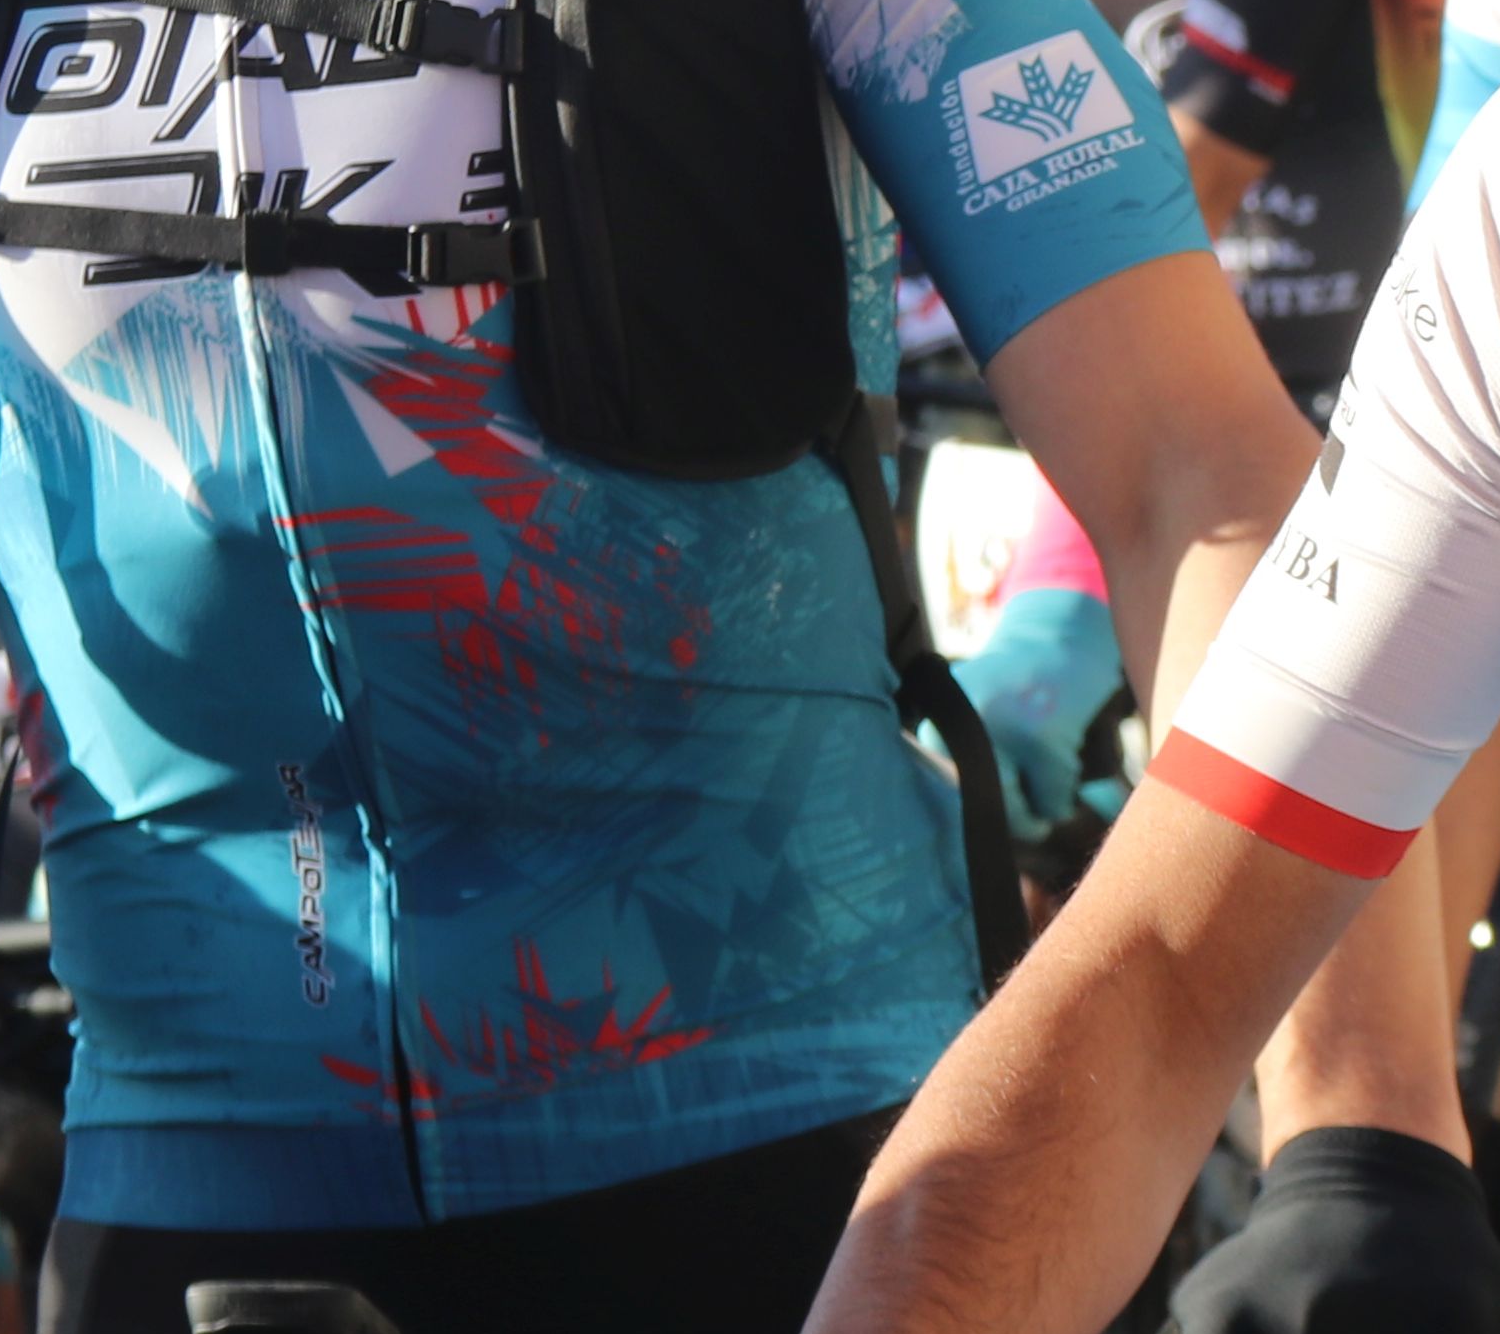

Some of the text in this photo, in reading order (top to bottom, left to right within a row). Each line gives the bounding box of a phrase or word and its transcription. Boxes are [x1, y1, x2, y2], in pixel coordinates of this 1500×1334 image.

[939, 79, 978, 196] fundación
[963, 128, 1145, 217] CAJA RURAL
[1006, 158, 1119, 213] GRANADA
